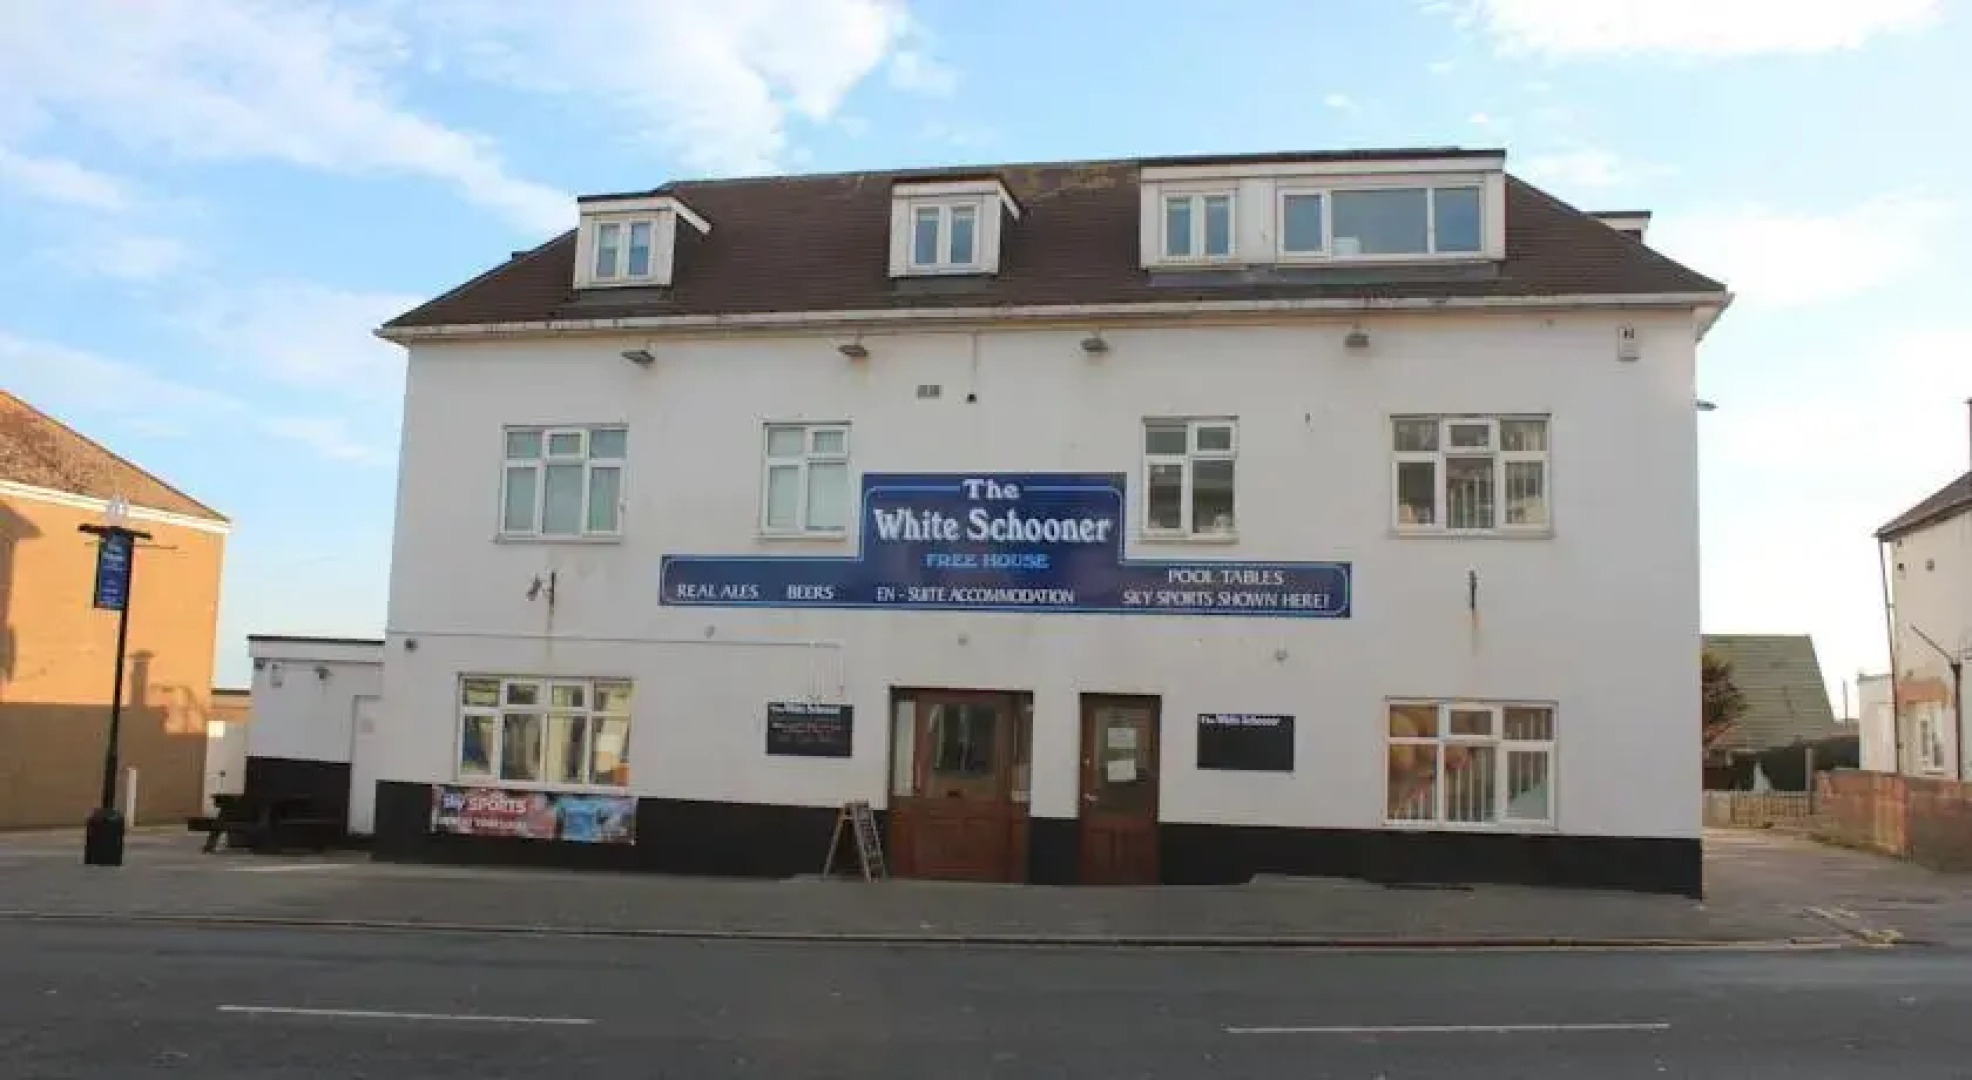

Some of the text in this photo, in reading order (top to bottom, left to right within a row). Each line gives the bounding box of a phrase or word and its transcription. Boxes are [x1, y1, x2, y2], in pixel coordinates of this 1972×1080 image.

[963, 478, 1020, 499] The
[873, 507, 1111, 542] White Schooner
[926, 553, 1050, 569] FREE HOUSE
[1168, 569, 1284, 585] POOL TABLES
[677, 584, 759, 600] REAL ALES
[787, 584, 834, 600] BEERS
[877, 586, 895, 601] EN
[908, 586, 946, 602] SUITE
[949, 587, 1074, 604] ACCOMMODATION
[1123, 591, 1330, 608] SKY SPORTS SHOWN HERE!
